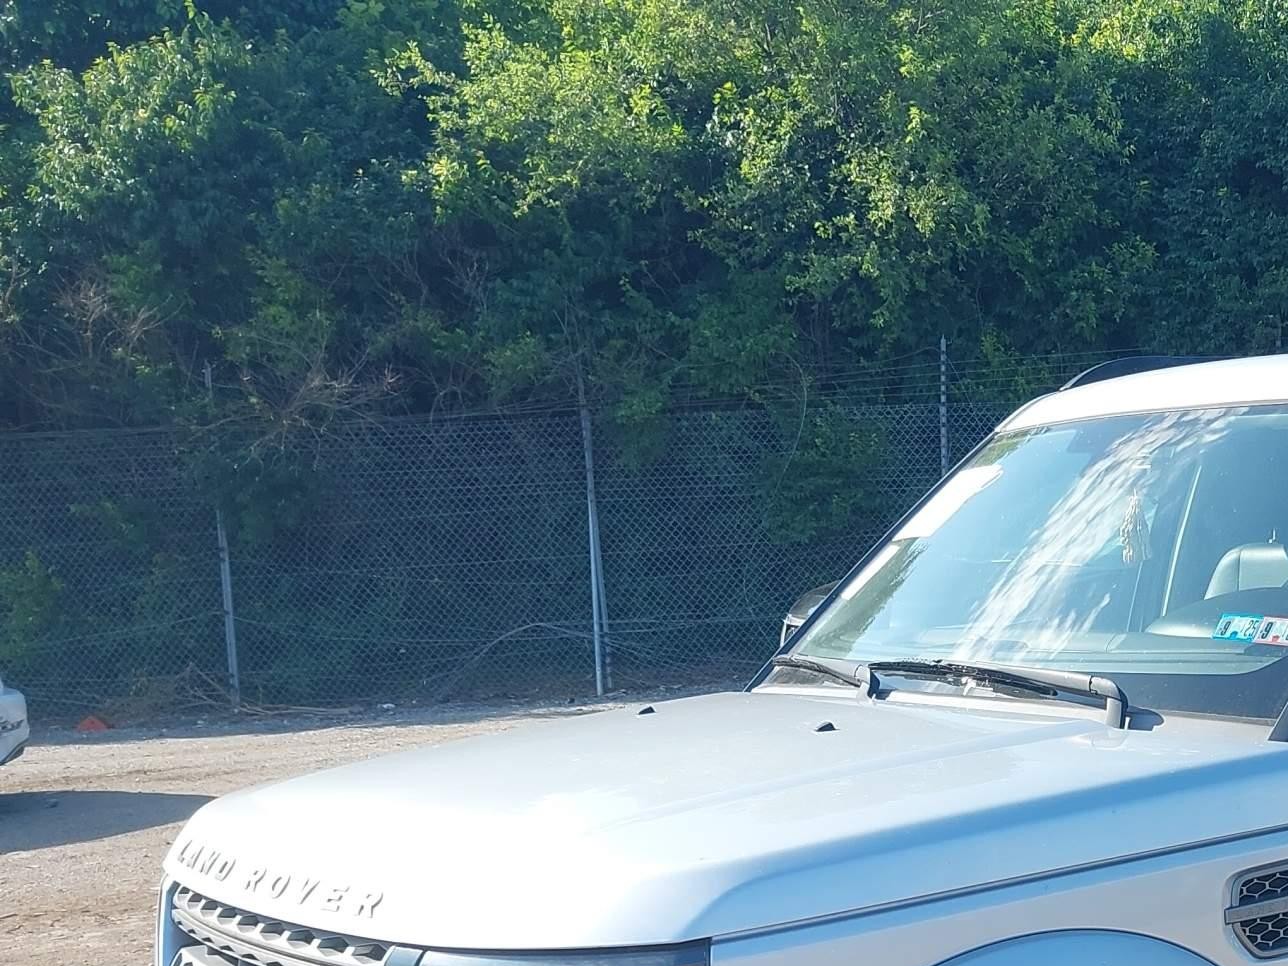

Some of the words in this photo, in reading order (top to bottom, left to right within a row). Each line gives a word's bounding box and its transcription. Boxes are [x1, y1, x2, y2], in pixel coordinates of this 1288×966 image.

[1220, 620, 1232, 636] 9
[1243, 619, 1259, 637] 25
[1260, 621, 1271, 639] 9
[176, 839, 237, 882] LAND
[244, 867, 384, 919] ROVER
